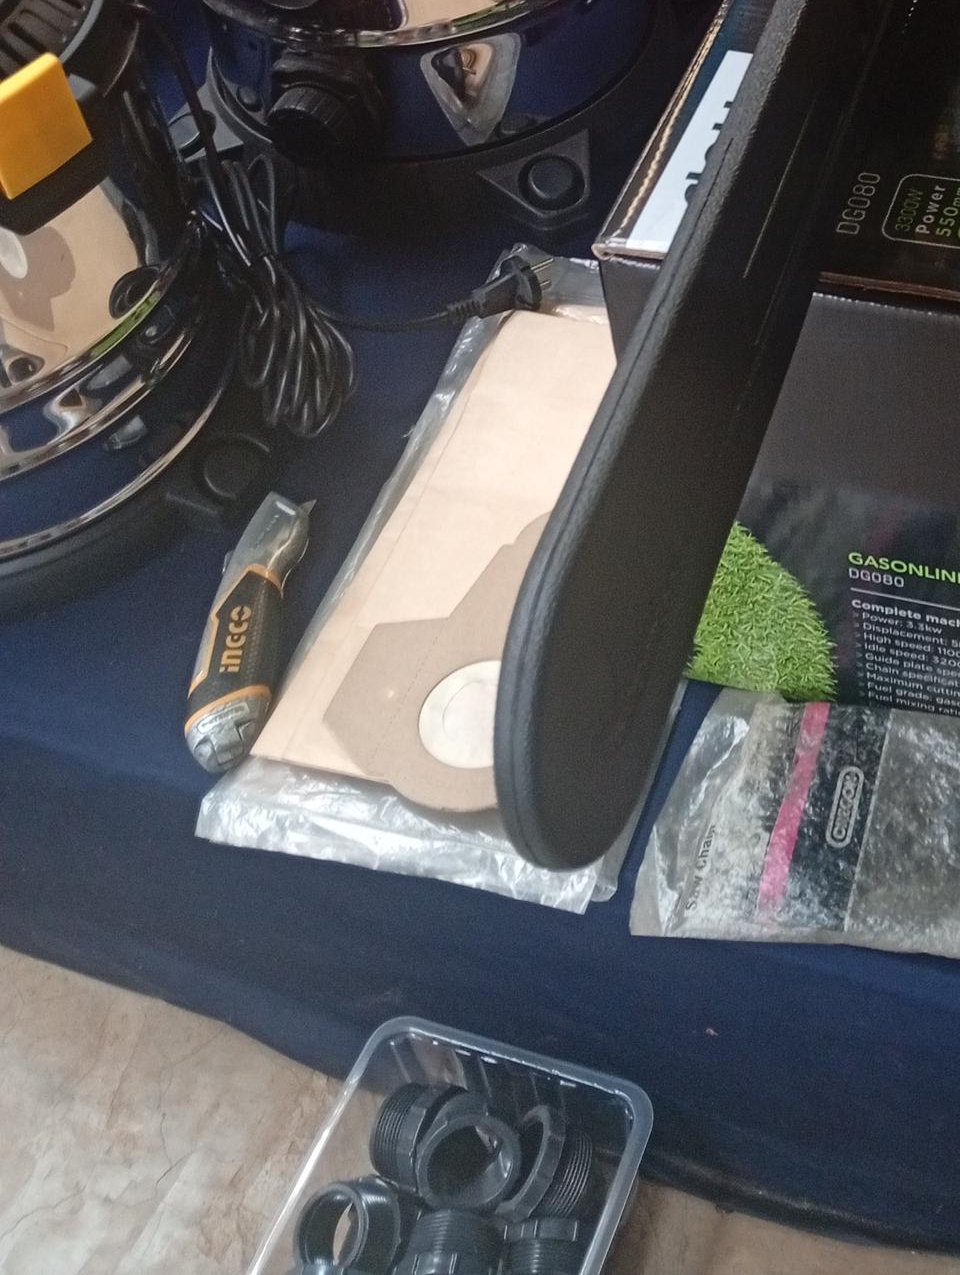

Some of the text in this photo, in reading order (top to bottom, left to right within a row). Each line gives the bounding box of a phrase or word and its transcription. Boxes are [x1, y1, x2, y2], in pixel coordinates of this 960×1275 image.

[836, 172, 881, 235] DG080
[915, 184, 947, 235] Power
[848, 567, 905, 588] DG080
[851, 599, 922, 620] Complete
[862, 612, 903, 626] Power:
[863, 622, 947, 646] Displacement:
[863, 632, 891, 645] High
[894, 640, 934, 653] speed:
[864, 642, 886, 653] Idle
[889, 648, 928, 662] speed:
[865, 652, 900, 665] Guide
[903, 660, 933, 673] plate
[866, 662, 899, 675] Chain
[866, 671, 923, 690] Maximum
[867, 681, 892, 694] Fuel
[868, 691, 893, 703] Fuel
[896, 698, 935, 713] mixing
